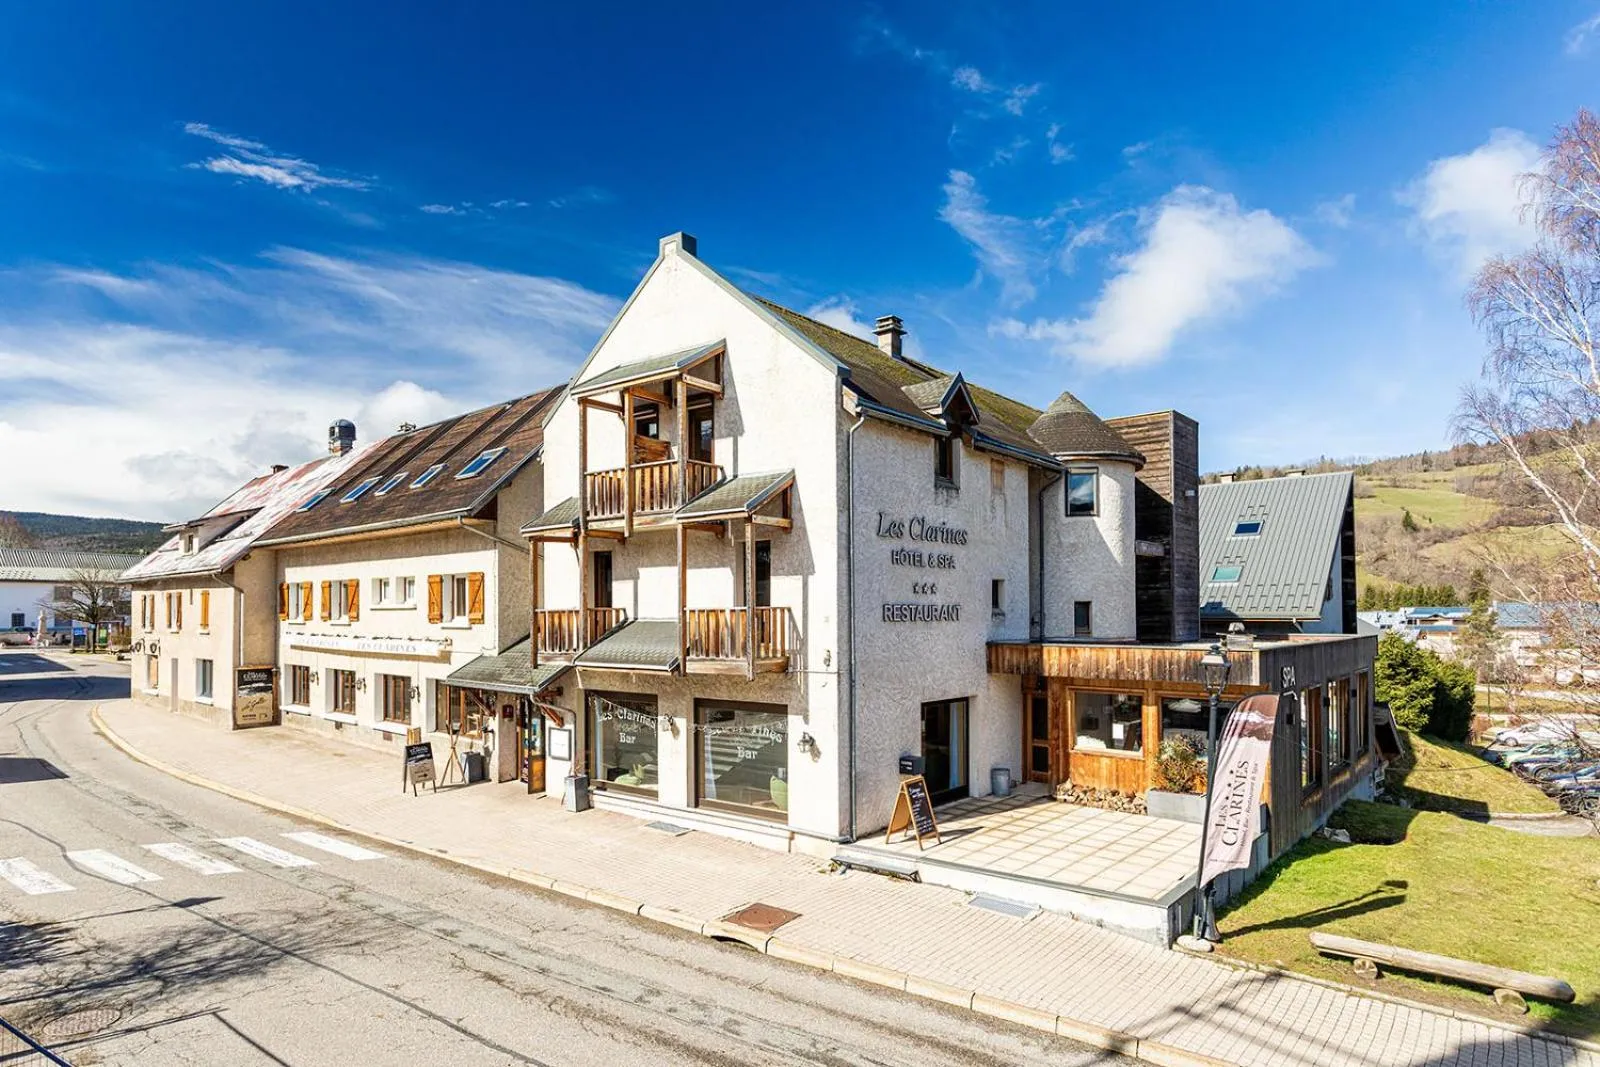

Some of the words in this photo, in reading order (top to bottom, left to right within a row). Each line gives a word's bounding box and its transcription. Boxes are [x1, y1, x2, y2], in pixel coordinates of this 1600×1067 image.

[877, 511, 904, 539] Les
[909, 516, 968, 545] Clarines
[891, 547, 925, 568] HÔTEL
[927, 552, 935, 568] &
[937, 553, 956, 569] SPA
[882, 603, 961, 622] RESTAURANT
[1282, 665, 1296, 688] SPA
[619, 732, 637, 744] Bar
[737, 746, 758, 760] Bar
[1221, 760, 1249, 846] CLARINES
[1215, 804, 1229, 828] LES
